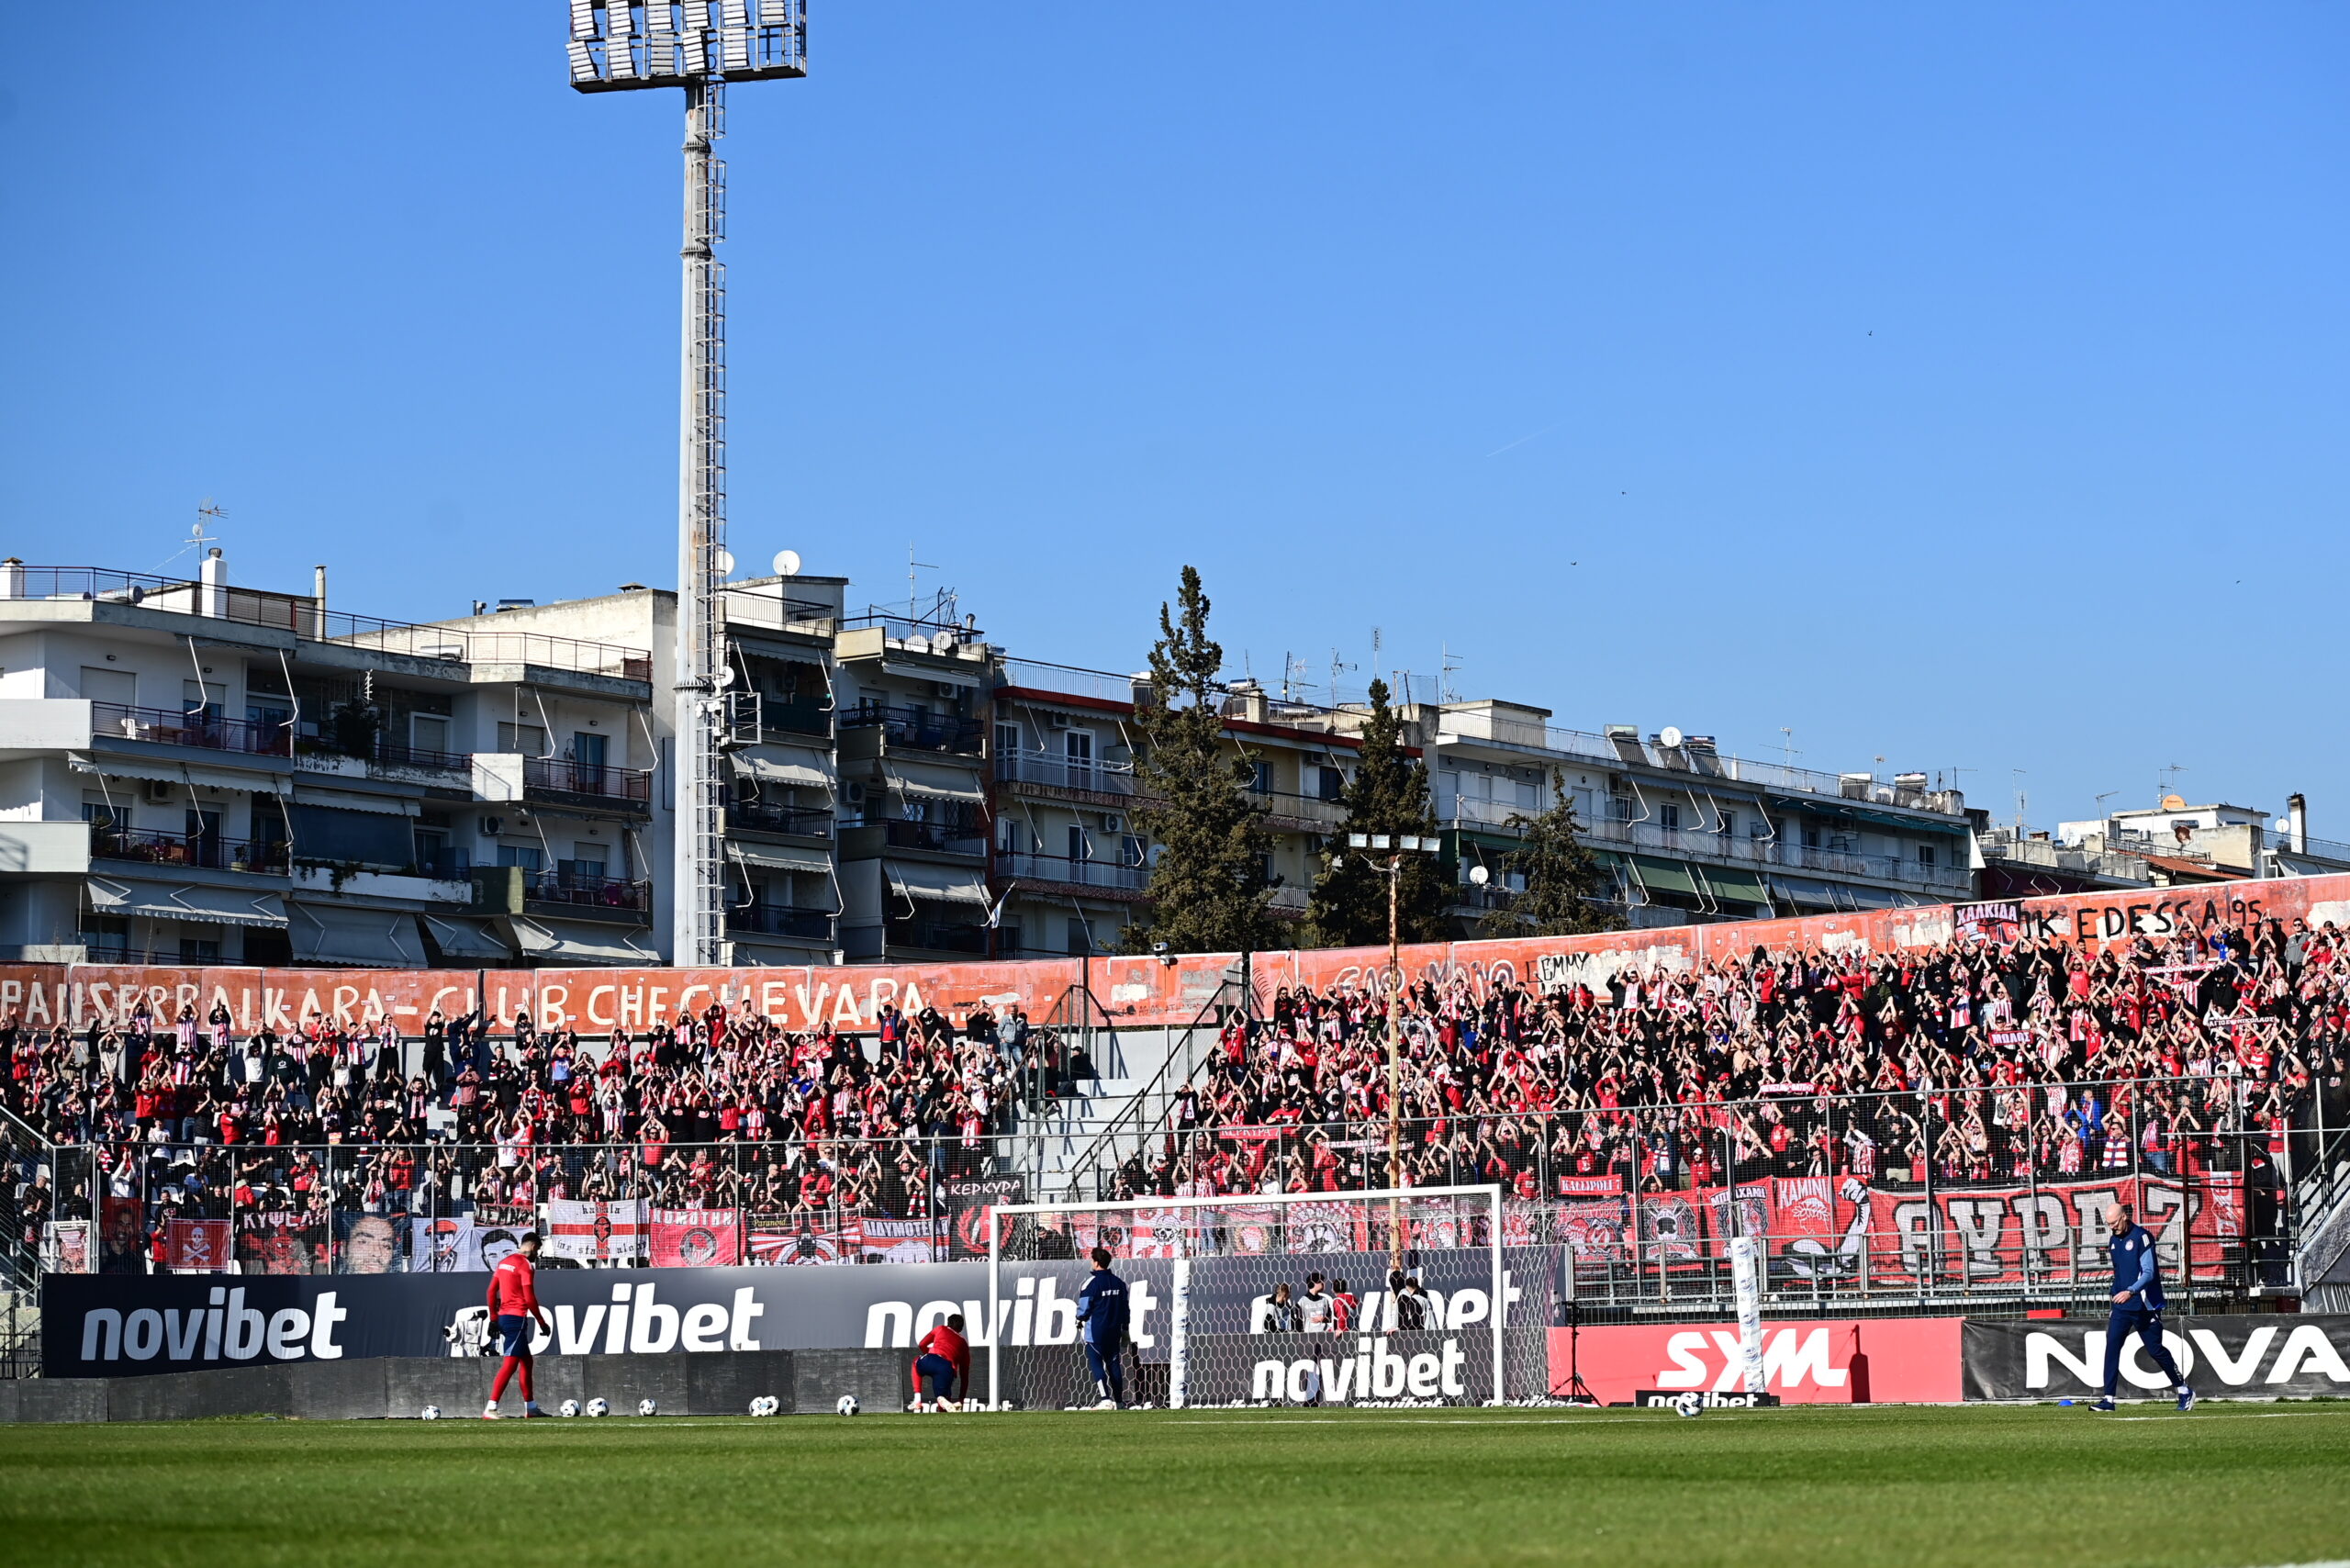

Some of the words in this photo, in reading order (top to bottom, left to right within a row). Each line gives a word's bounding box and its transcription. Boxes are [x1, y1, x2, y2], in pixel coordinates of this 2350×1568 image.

[1956, 903, 2017, 926] ΧΑΛΚΙΔΑ
[2077, 900, 2220, 938] EDESSA
[1526, 952, 1590, 983] LEMMY
[430, 985, 568, 1029] CLUB
[588, 985, 669, 1025] CHE
[1992, 1031, 2031, 1044] ΜΩΛΟΣ
[951, 1180, 1021, 1195] ΚΕΡΚΥΡΑ
[1561, 1179, 1612, 1192] KALLIPOLI
[1616, 1179, 1621, 1191] 7
[653, 1209, 736, 1226] ΚΟΜΟΤΗΝ
[2145, 1182, 2202, 1269] 7
[81, 1286, 347, 1361] novibet
[864, 1276, 1157, 1349] novibt
[1252, 1337, 1465, 1403] novibet
[2025, 1325, 2350, 1389] NOVA
[1648, 1391, 1758, 1407] noibet
